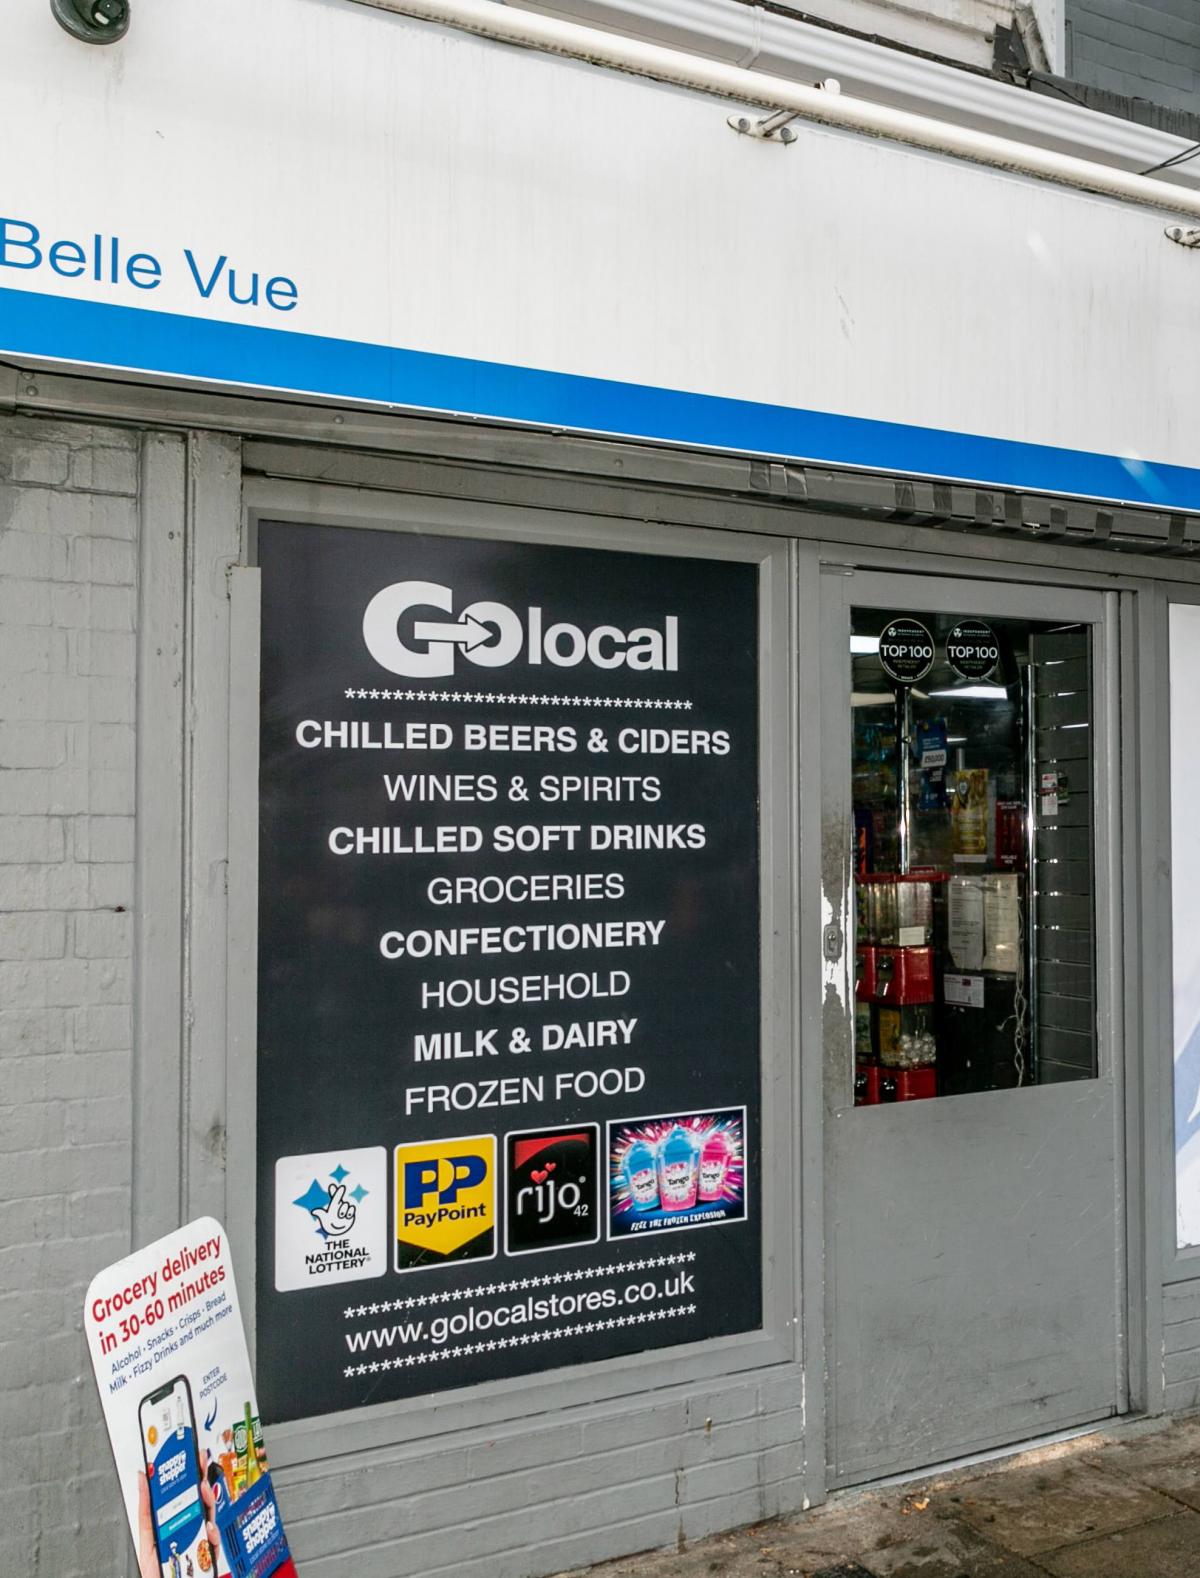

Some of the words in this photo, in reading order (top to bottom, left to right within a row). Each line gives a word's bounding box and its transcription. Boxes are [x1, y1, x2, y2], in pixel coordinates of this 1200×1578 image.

[0, 217, 162, 290] Belle
[183, 248, 299, 312] Vue
[880, 644, 908, 657] TOP
[908, 645, 933, 659] 100
[947, 645, 974, 658] TOP
[975, 646, 999, 660] 100
[295, 720, 453, 751] CHILLED
[464, 725, 577, 754] BEERS
[587, 727, 608, 754] &
[618, 728, 731, 755] CIDERS
[384, 774, 498, 801] WINES
[508, 776, 530, 802] &
[539, 776, 662, 802] SPIRITS
[328, 826, 483, 855] CHILLED
[493, 825, 581, 853] SOFT
[591, 824, 707, 851] DRINKS
[426, 873, 626, 905] GROCERIES
[379, 920, 666, 959] CONFECTIONERY
[421, 970, 631, 1009] HOUSEHOLD
[414, 1029, 499, 1063] MILK
[509, 1027, 532, 1054] &
[542, 1018, 638, 1051] DAIRY
[405, 1075, 544, 1116] FROZEN
[555, 1067, 646, 1100] FOOD
[667, 1174, 690, 1187] Tango
[702, 1171, 720, 1180] Tango
[404, 1203, 487, 1229] PayPoint
[573, 1202, 589, 1218] 42
[305, 1247, 369, 1265] NATIONAL
[325, 1239, 351, 1251] THE
[92, 1271, 158, 1323] Grocery
[162, 1235, 222, 1283] delivery
[98, 1331, 118, 1355] in
[119, 1300, 165, 1343] 30-60
[168, 1264, 226, 1313] minutes
[345, 1270, 696, 1354] www.golocalstores.co.uk
[109, 1376, 128, 1394] Milk
[132, 1356, 153, 1379] Fizzy
[154, 1340, 179, 1364] Drinks
[179, 1331, 194, 1348] and
[194, 1316, 215, 1338] much
[215, 1304, 233, 1322] more
[111, 1348, 142, 1375] Alcohol
[146, 1326, 174, 1351] Snacks
[178, 1308, 201, 1330] Crisps
[205, 1292, 227, 1312] Bread
[199, 1373, 228, 1398] POSTCODE
[202, 1366, 220, 1385] ENTER
